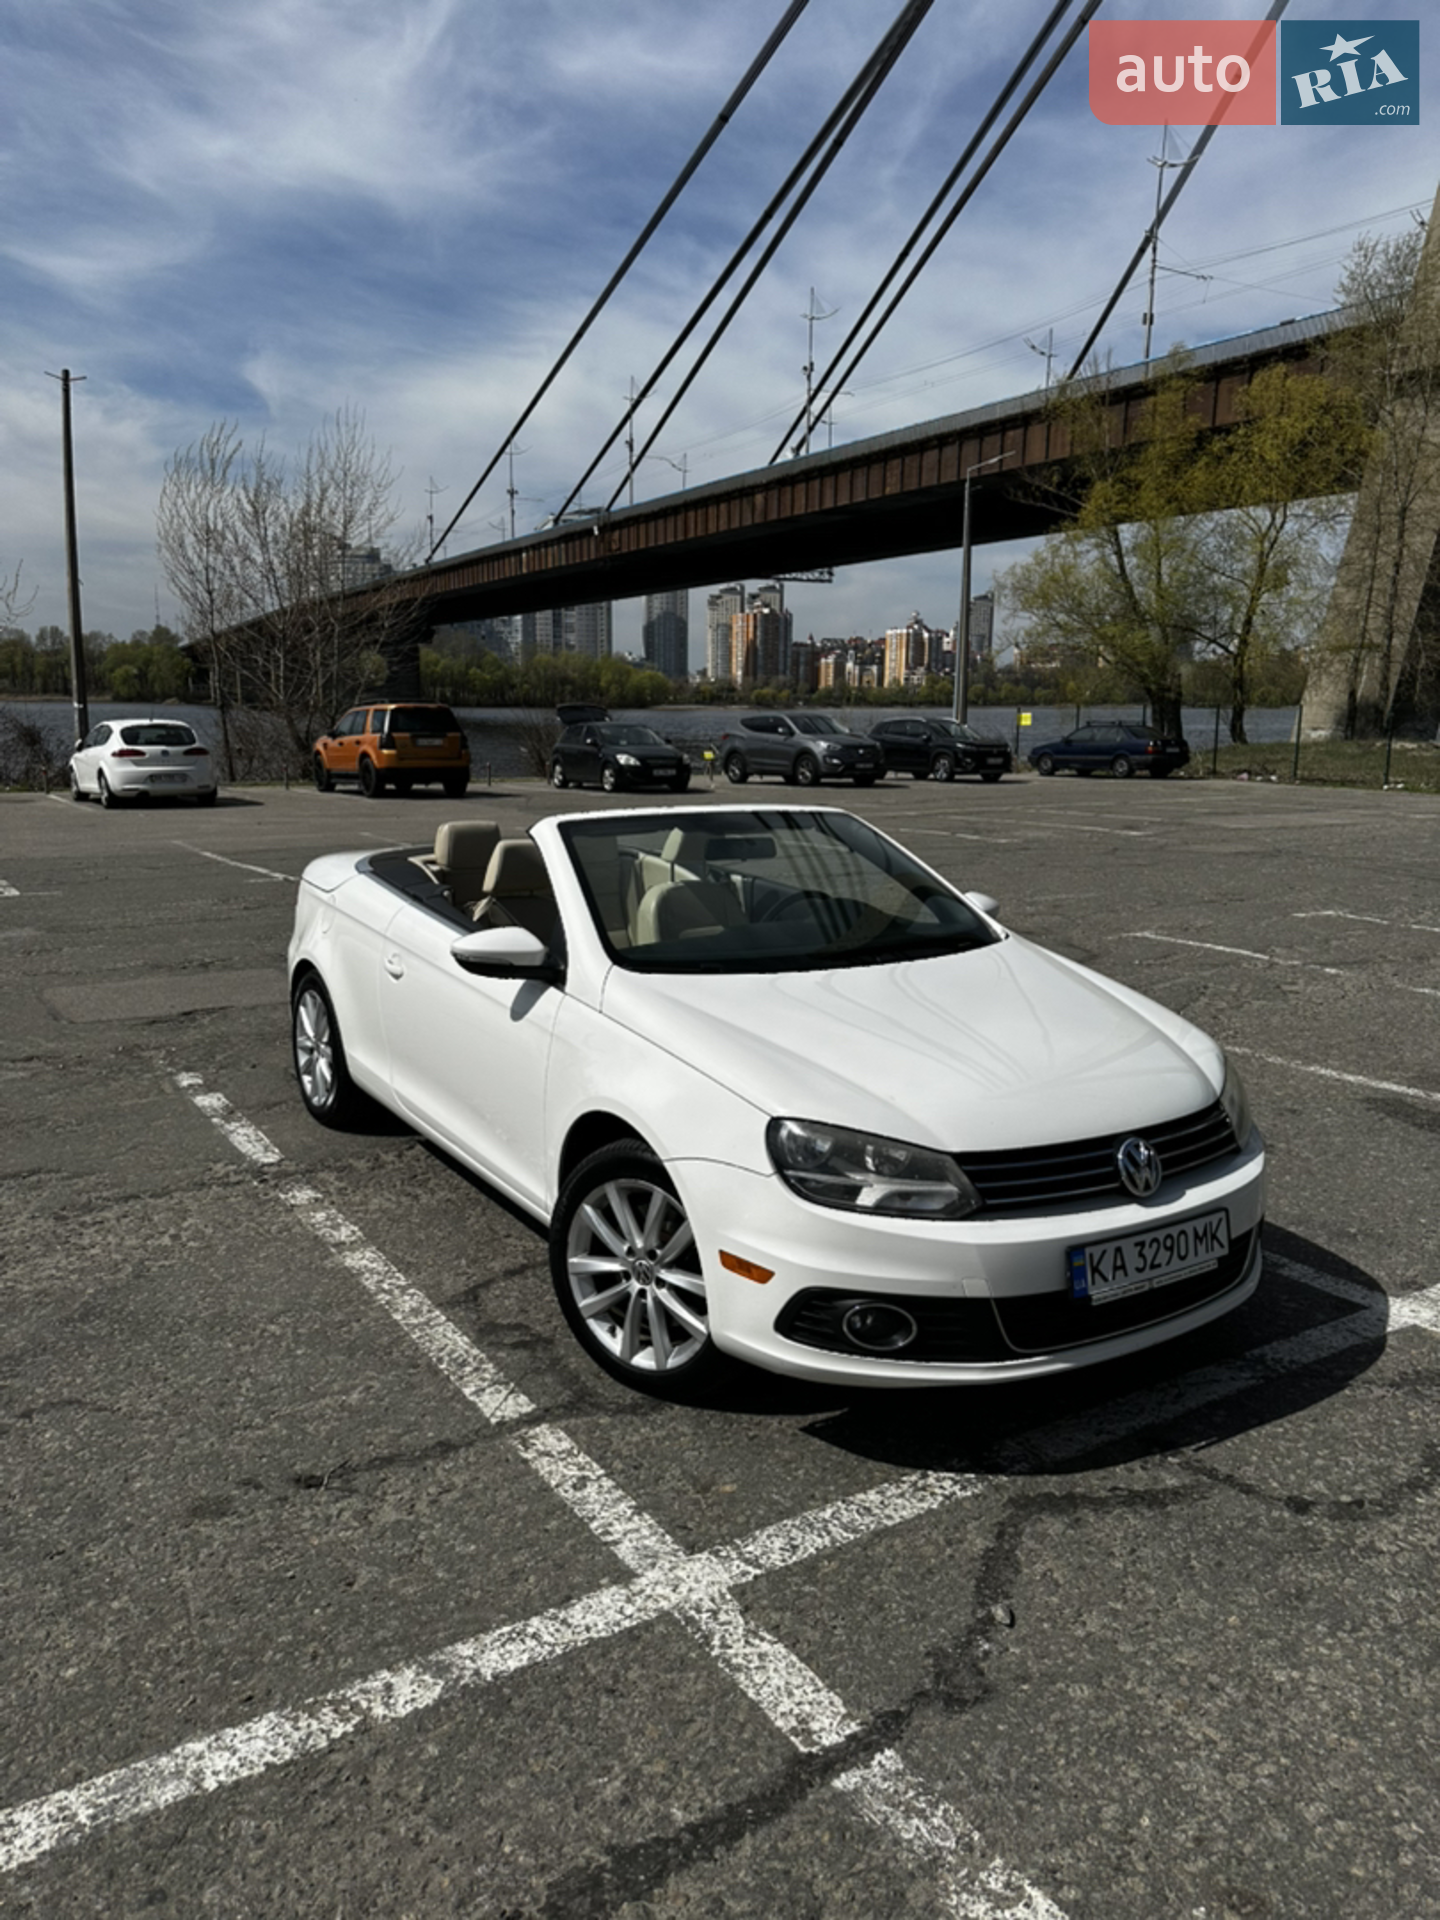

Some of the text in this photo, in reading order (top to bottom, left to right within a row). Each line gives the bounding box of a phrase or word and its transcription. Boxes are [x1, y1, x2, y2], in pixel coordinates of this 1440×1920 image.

[1089, 1246, 1129, 1286] KA
[1134, 1229, 1189, 1274] 3290
[1193, 1217, 1225, 1258] MK
